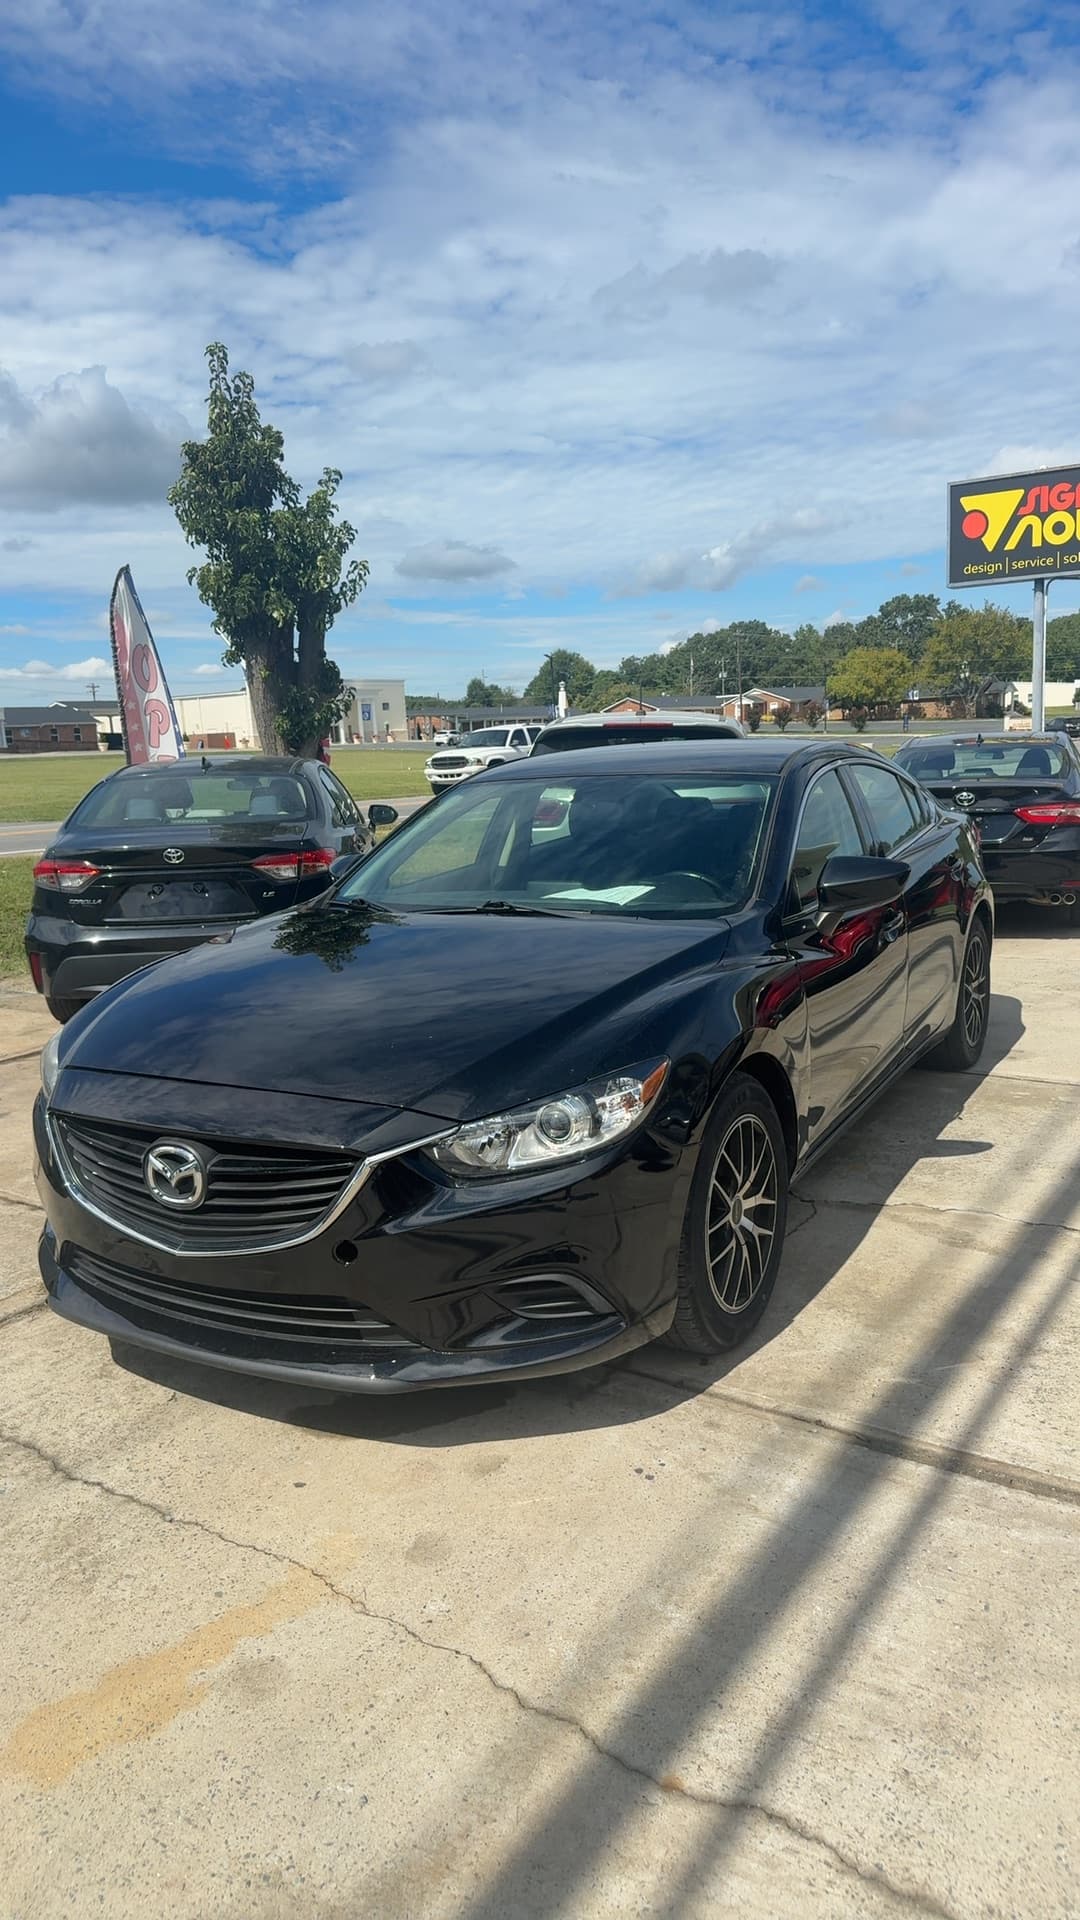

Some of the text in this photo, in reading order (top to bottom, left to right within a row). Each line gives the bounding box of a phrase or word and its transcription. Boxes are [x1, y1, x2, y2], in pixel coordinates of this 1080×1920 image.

[963, 562, 1003, 575] design
[1011, 556, 1054, 570] service
[132, 644, 177, 760] OP
